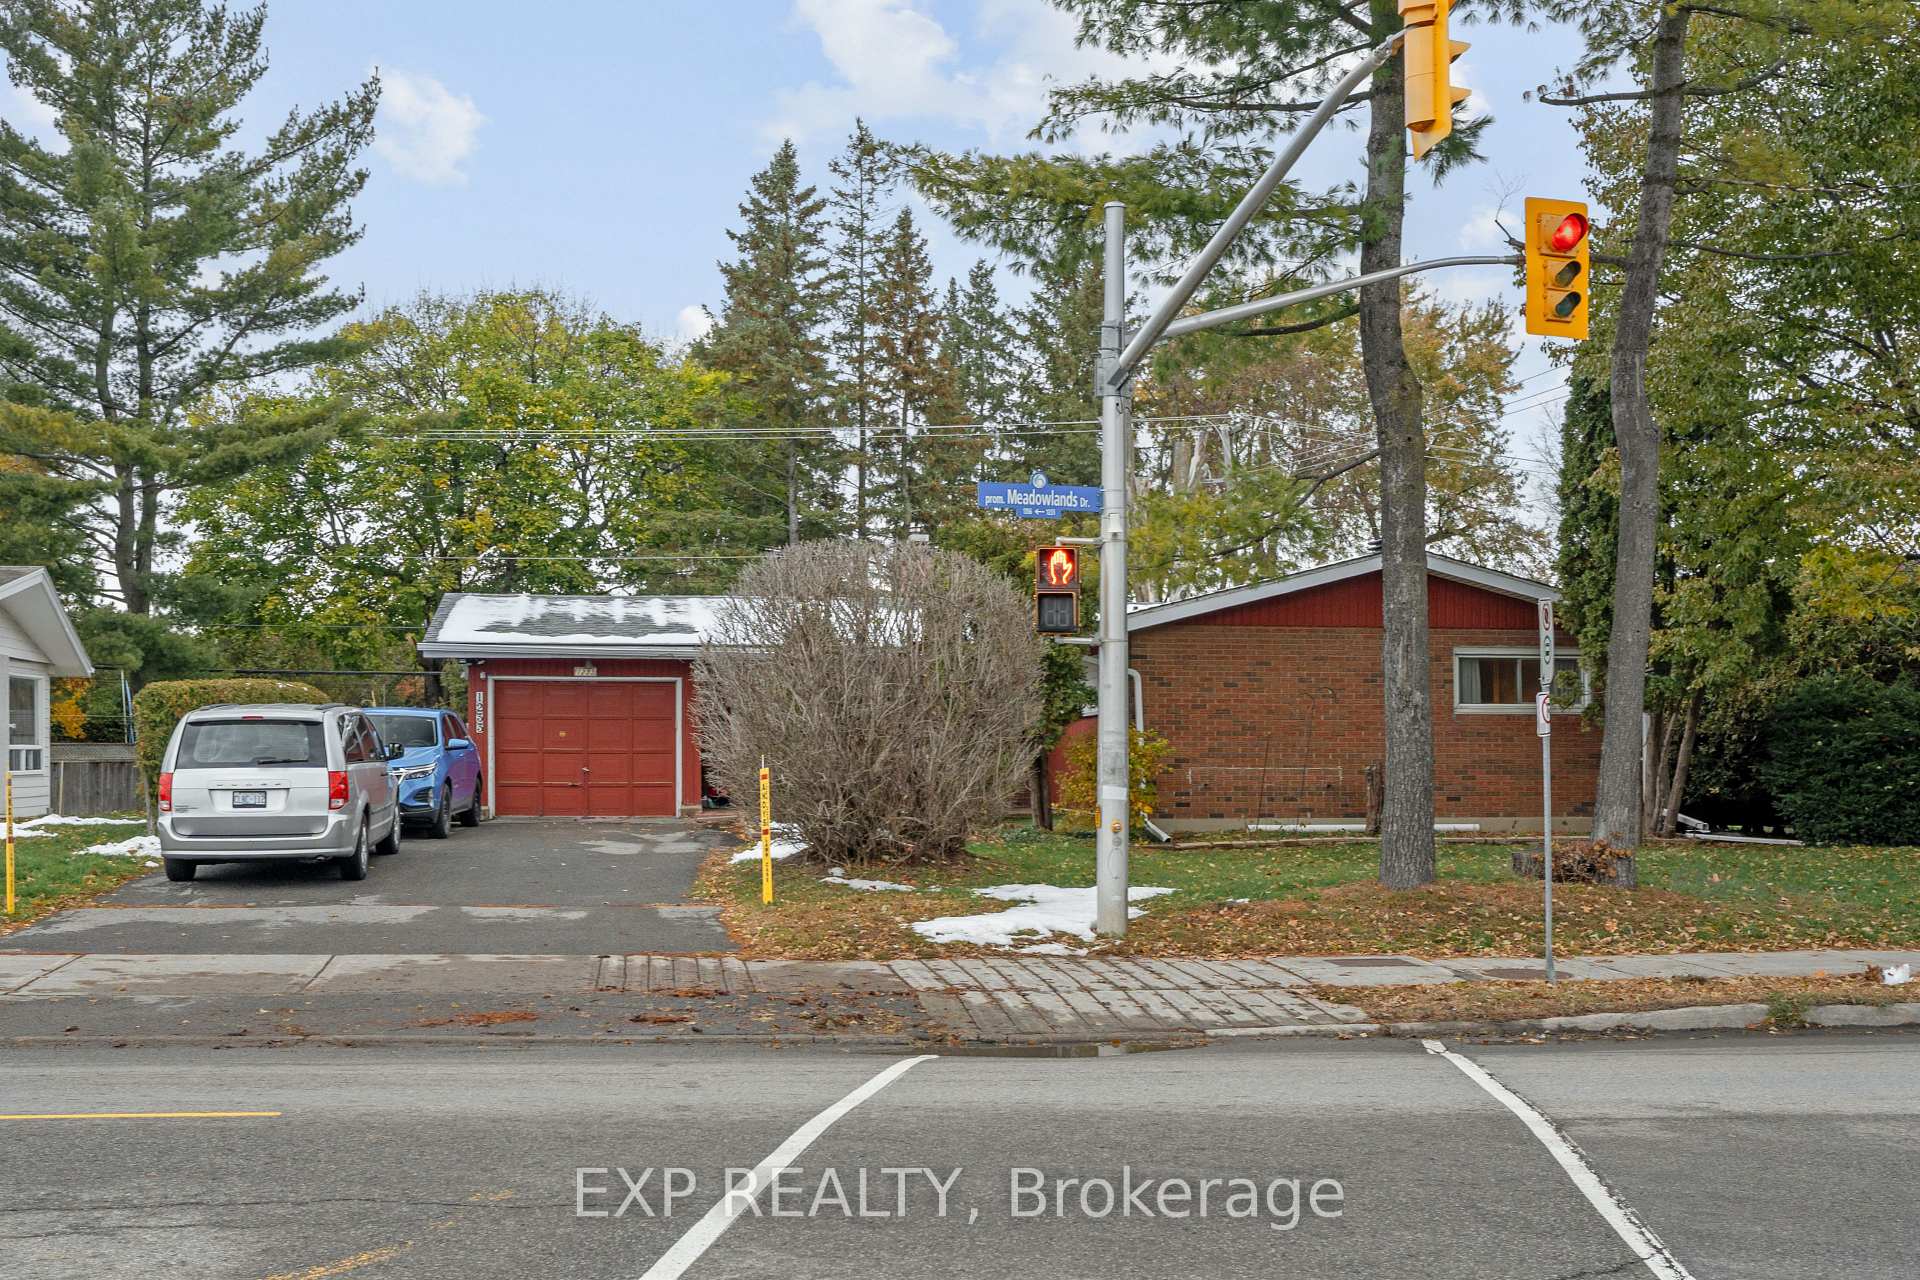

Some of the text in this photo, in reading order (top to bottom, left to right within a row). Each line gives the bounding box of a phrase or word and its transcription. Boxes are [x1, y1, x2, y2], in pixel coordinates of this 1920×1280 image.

[985, 489, 1091, 508] prom. Meadowlands Dr.
